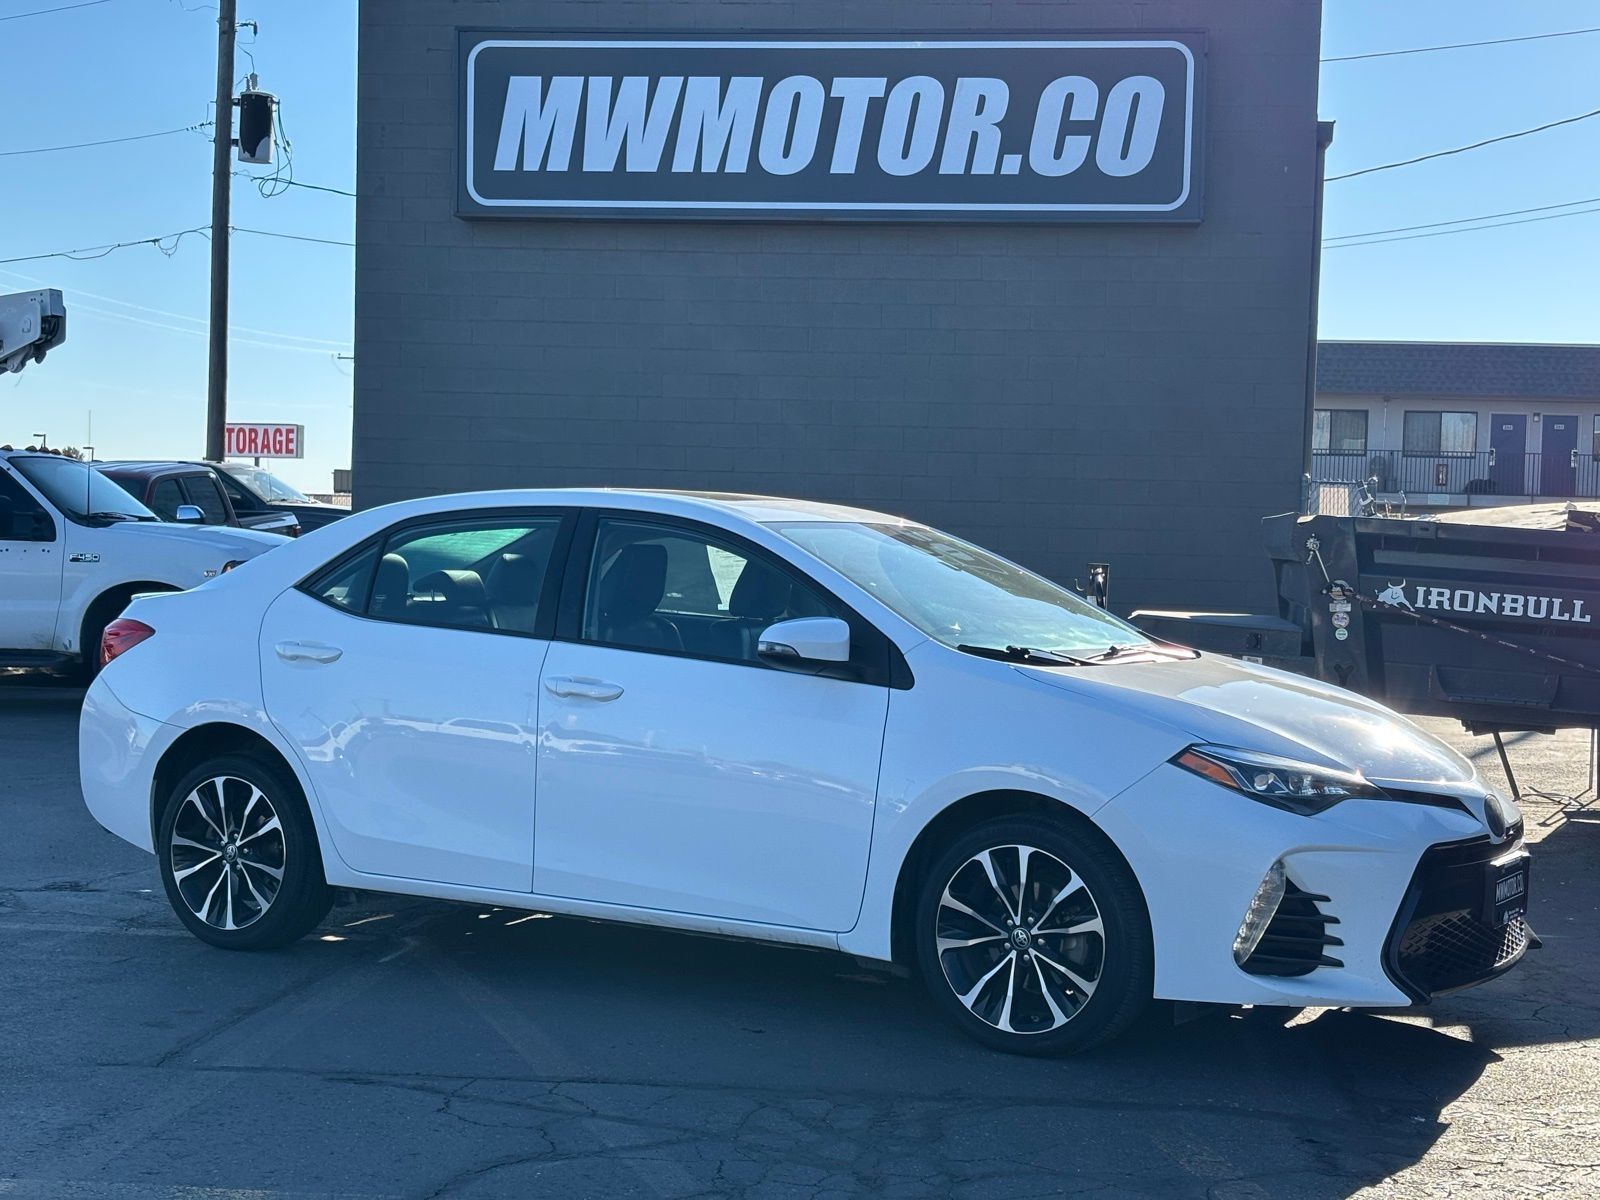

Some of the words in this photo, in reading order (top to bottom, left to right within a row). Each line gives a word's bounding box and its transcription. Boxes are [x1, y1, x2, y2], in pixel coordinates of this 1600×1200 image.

[493, 75, 1166, 177] MWMOTOR.CO
[225, 427, 295, 455] TORAGE
[1414, 586, 1591, 623] IRONBULL
